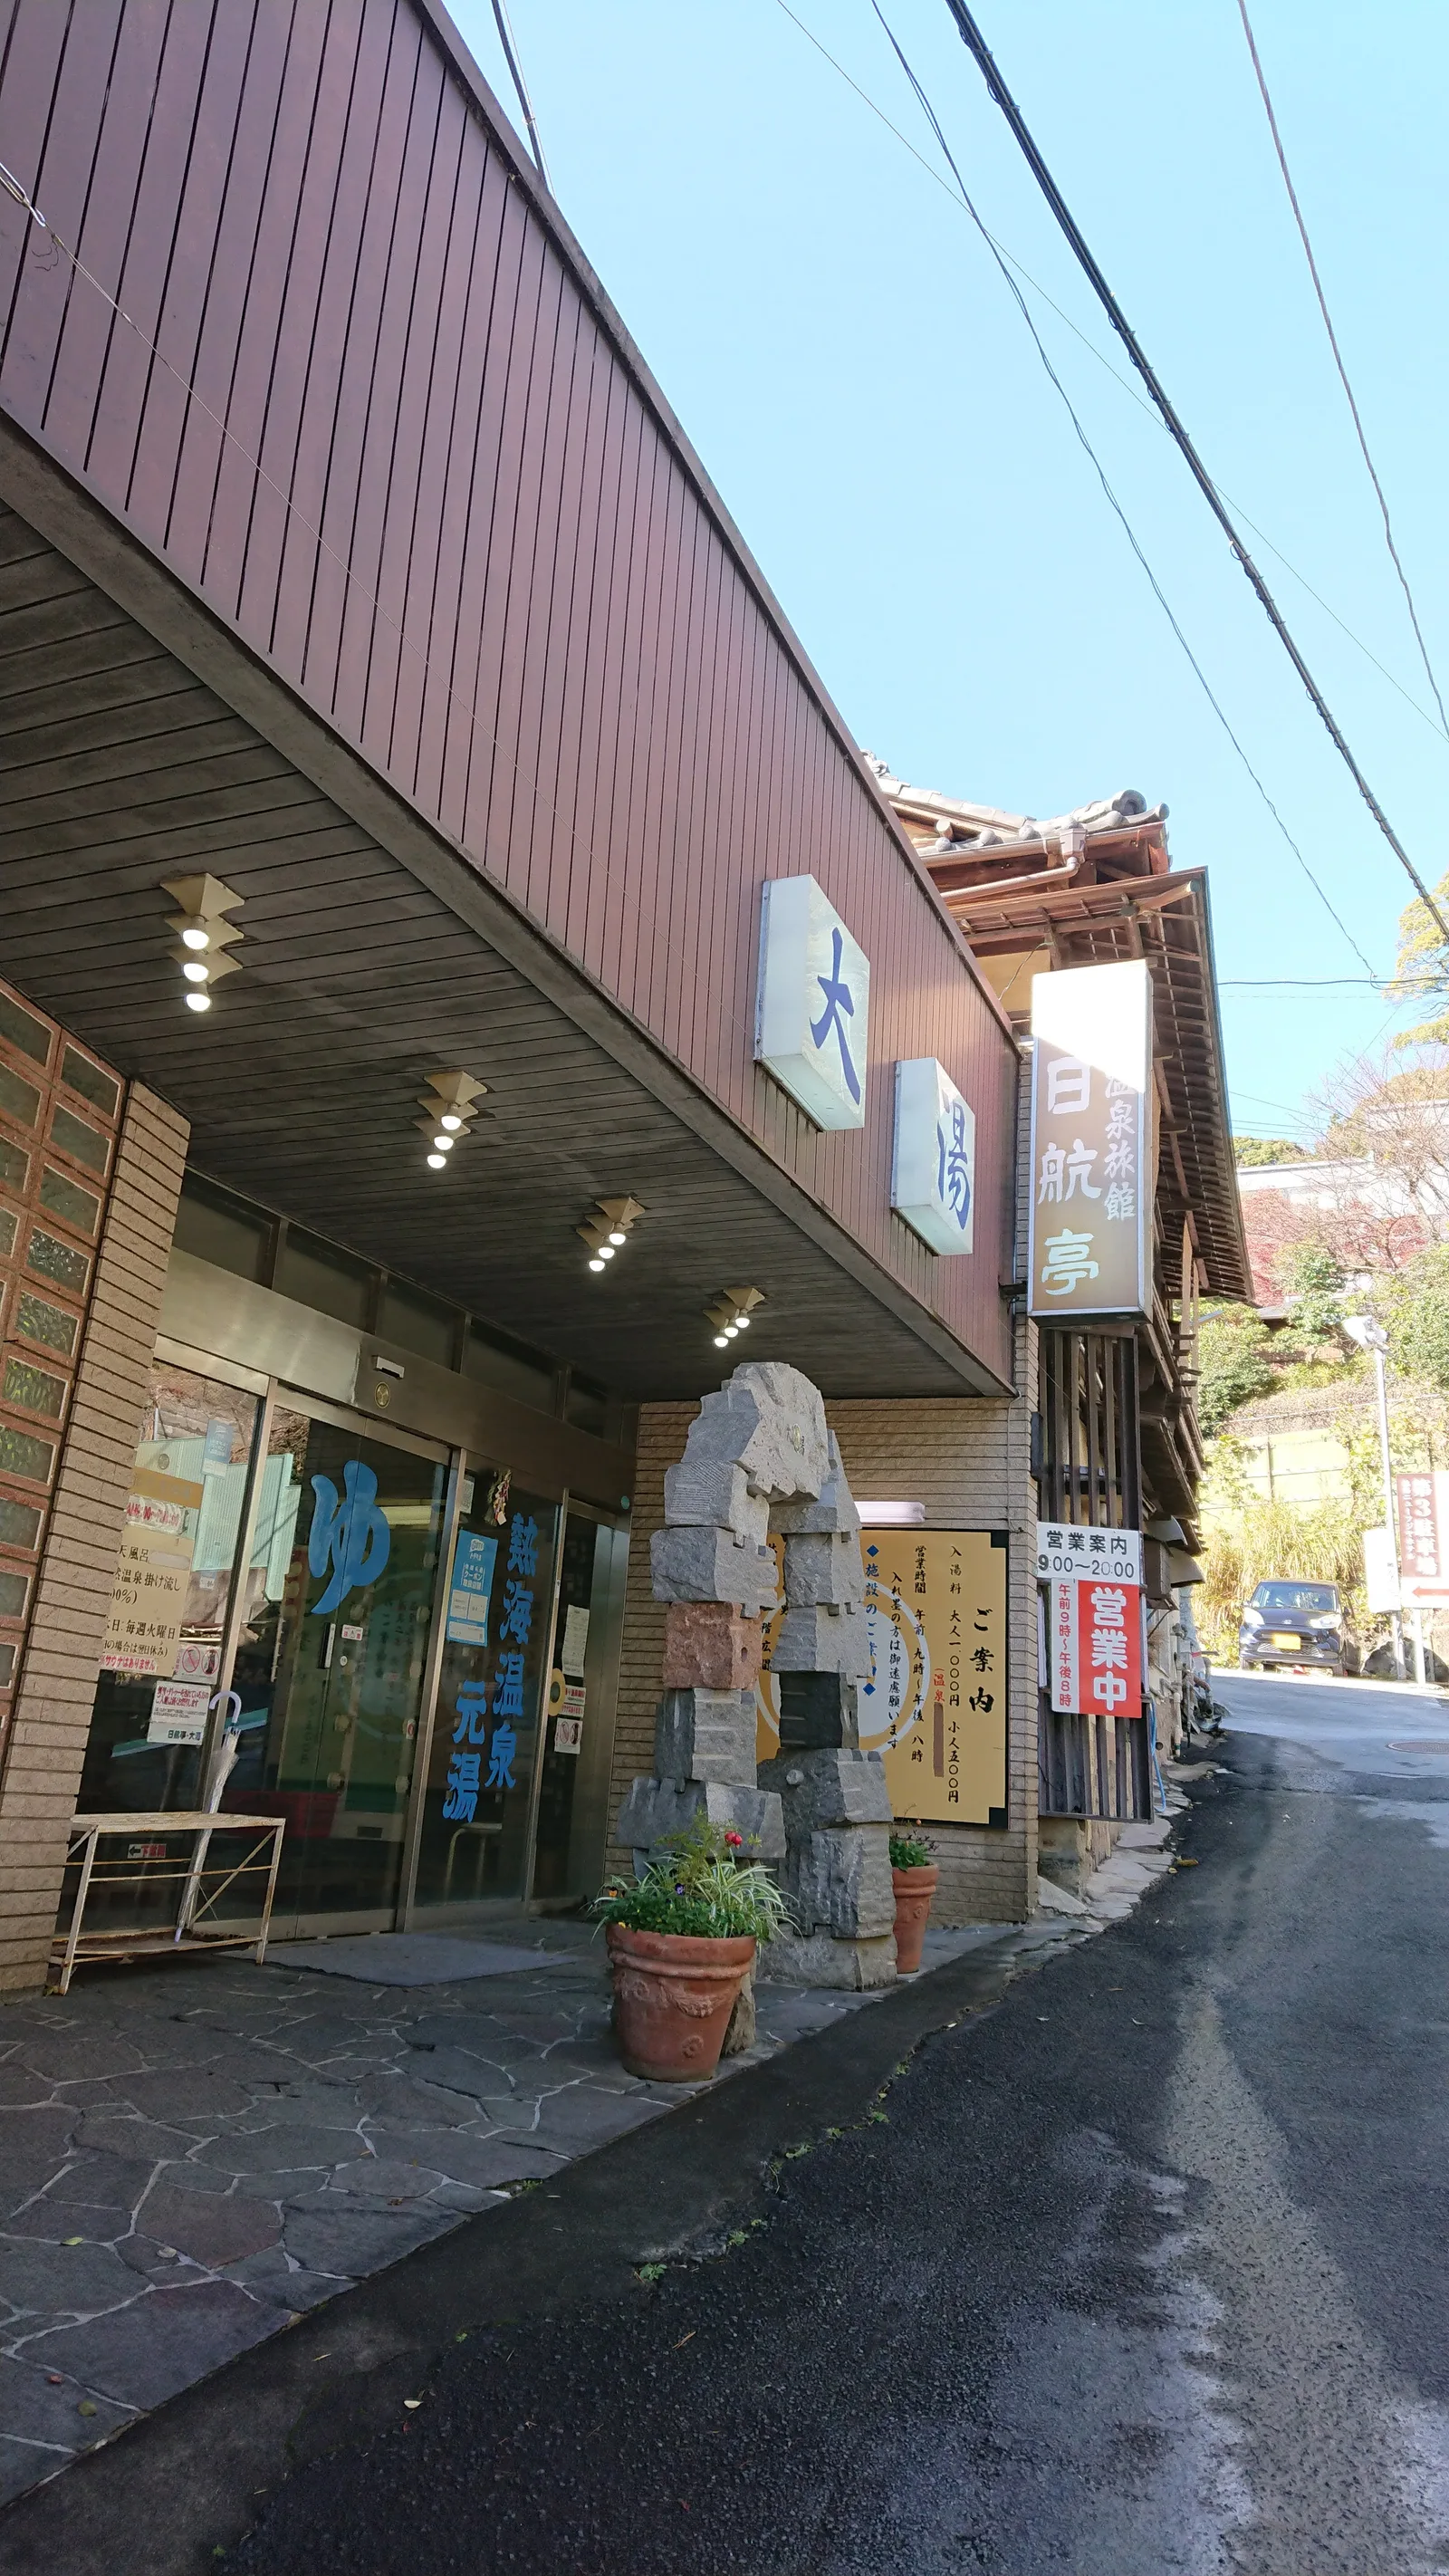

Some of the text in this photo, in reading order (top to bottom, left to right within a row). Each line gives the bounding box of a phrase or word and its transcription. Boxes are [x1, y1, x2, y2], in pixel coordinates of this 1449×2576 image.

[809, 927, 860, 1105] 大
[937, 1092, 971, 1230] 湯
[1037, 1057, 1103, 1296] 日航亭
[309, 1460, 390, 1614] ゆ
[949, 1545, 962, 1594] 入湯料
[1047, 1530, 1127, 1555] 営業案内
[485, 1513, 540, 1790] 熱海温泉
[866, 1564, 879, 1677] 施設のご
[888, 1572, 902, 1749] 入れ墨の方は御遠慮願います
[969, 1608, 994, 1714] ご案内
[1090, 1587, 1128, 1711] 営業中
[442, 1679, 487, 1823] 元湯
